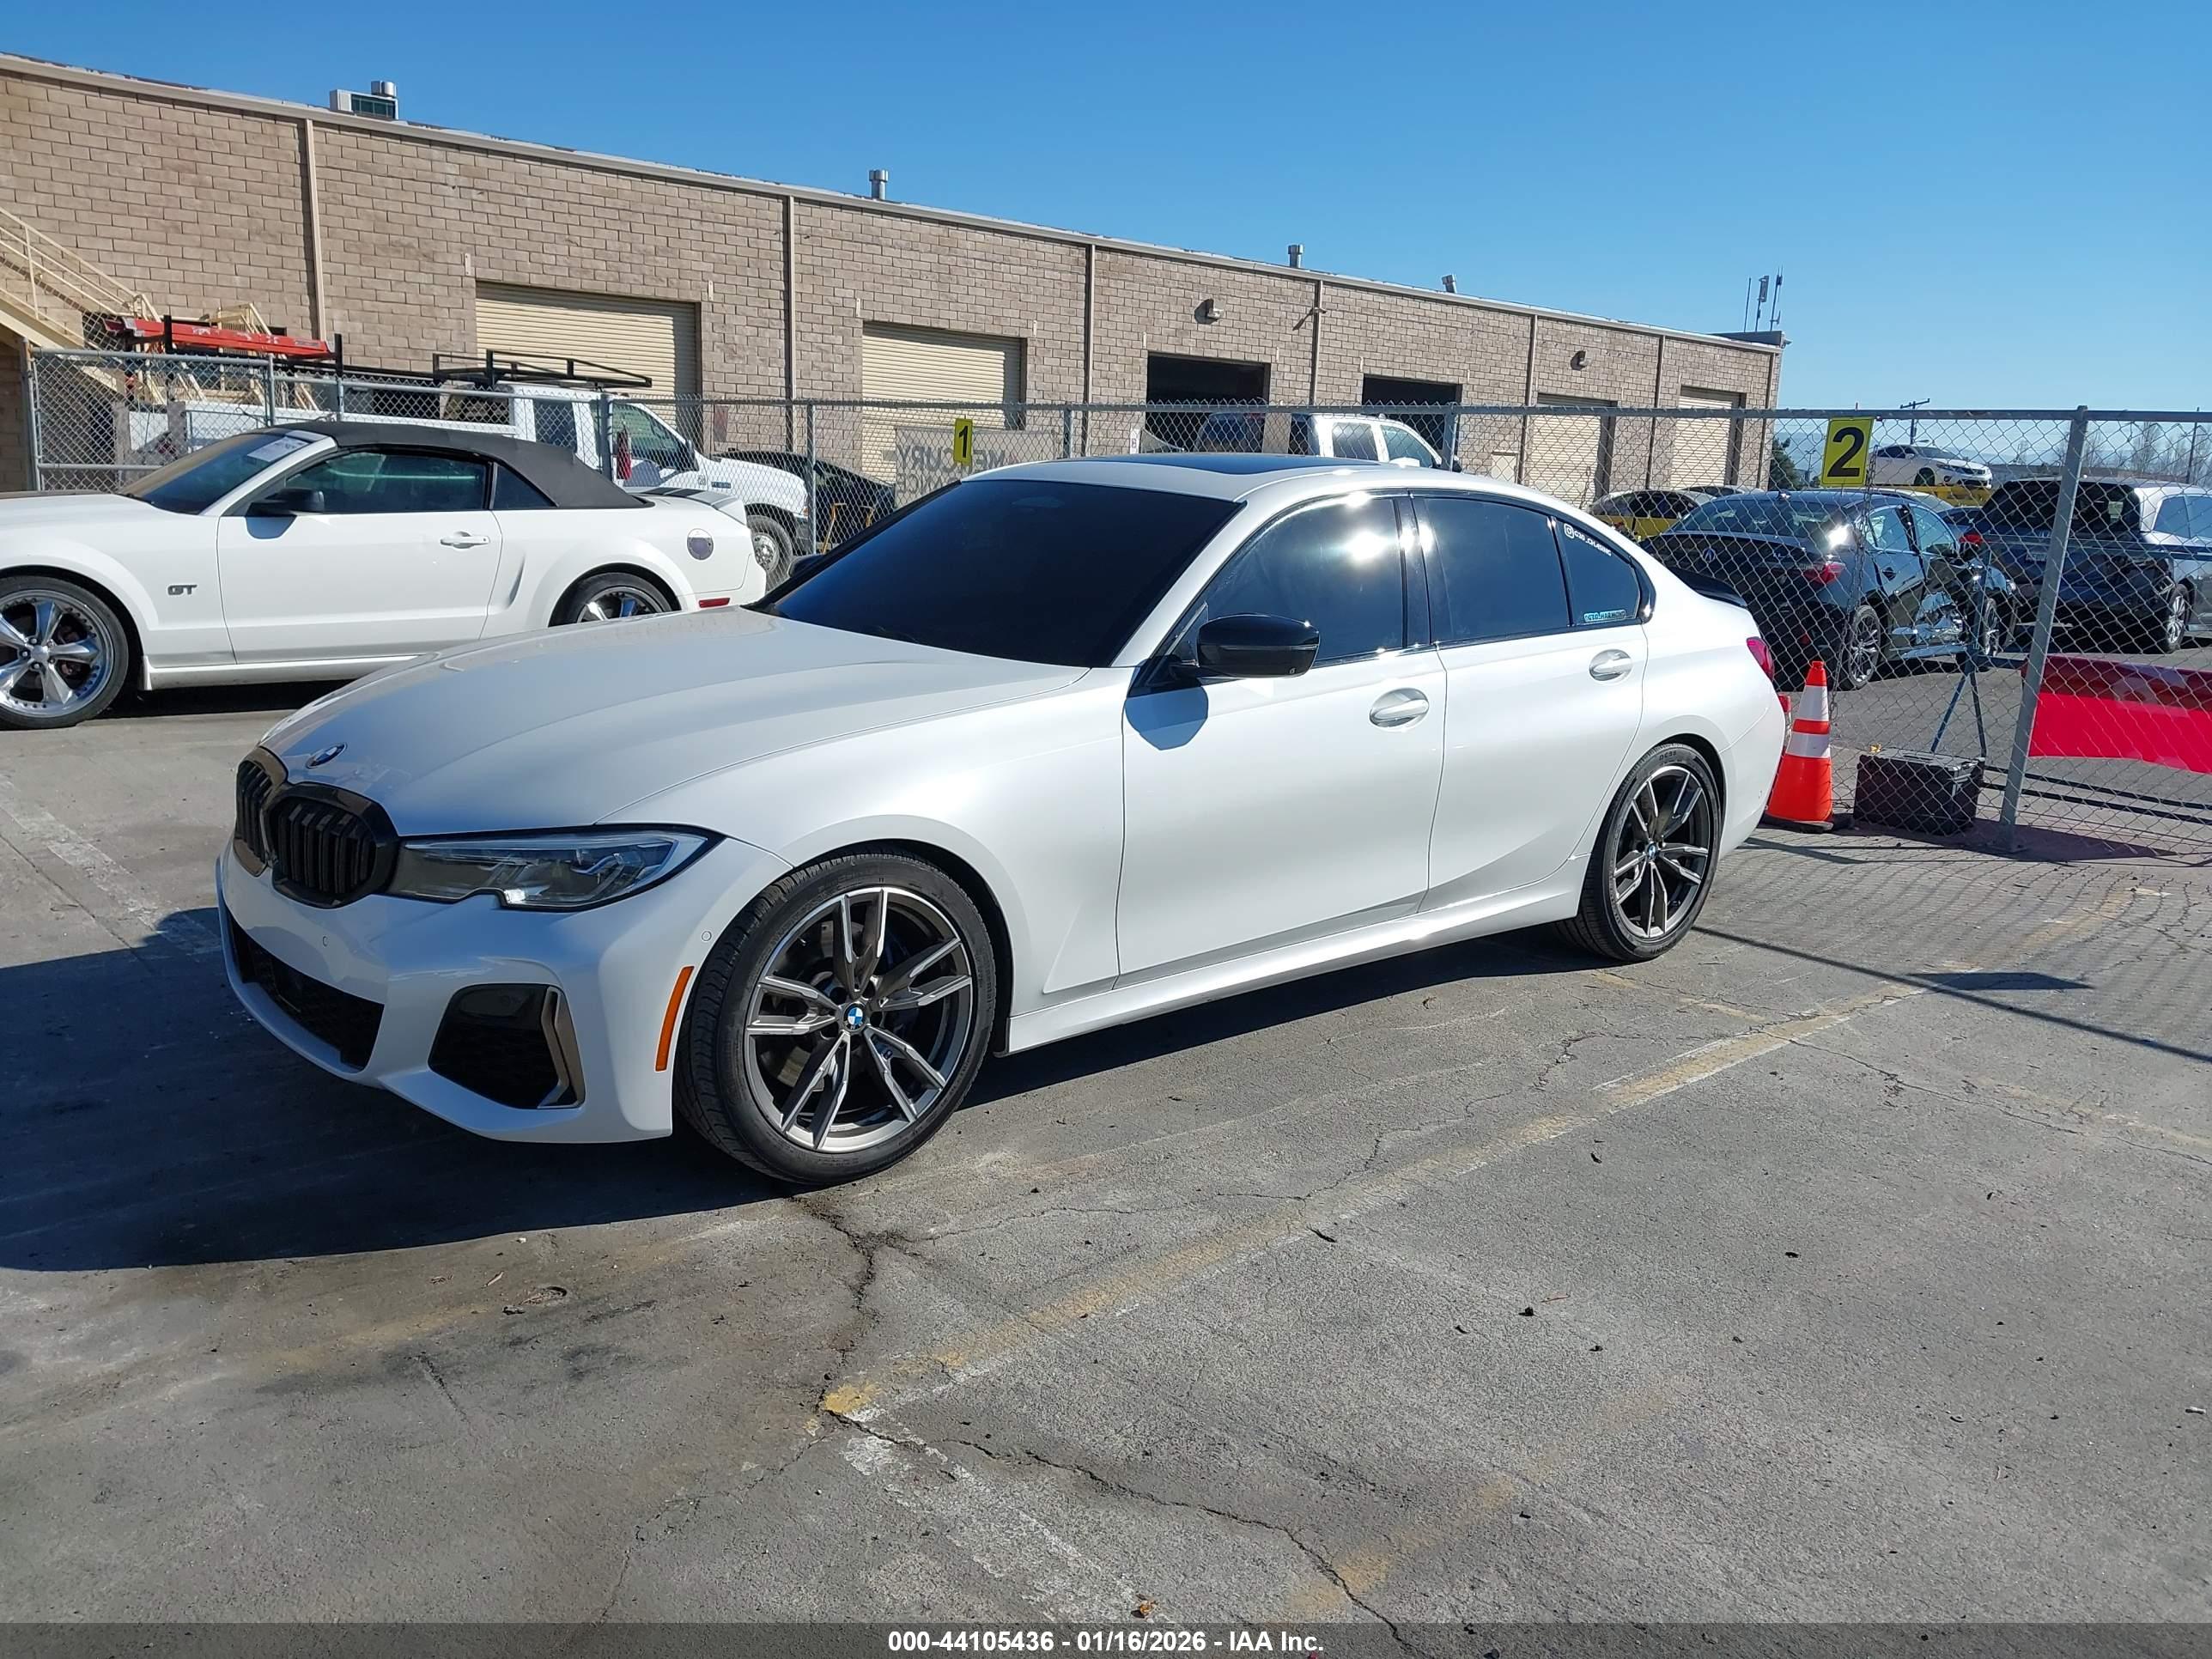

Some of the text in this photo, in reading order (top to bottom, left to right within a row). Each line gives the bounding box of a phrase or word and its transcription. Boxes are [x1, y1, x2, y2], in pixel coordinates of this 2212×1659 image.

[958, 426, 969, 459] 1
[1826, 426, 1864, 477] 2
[167, 584, 198, 595] GT
